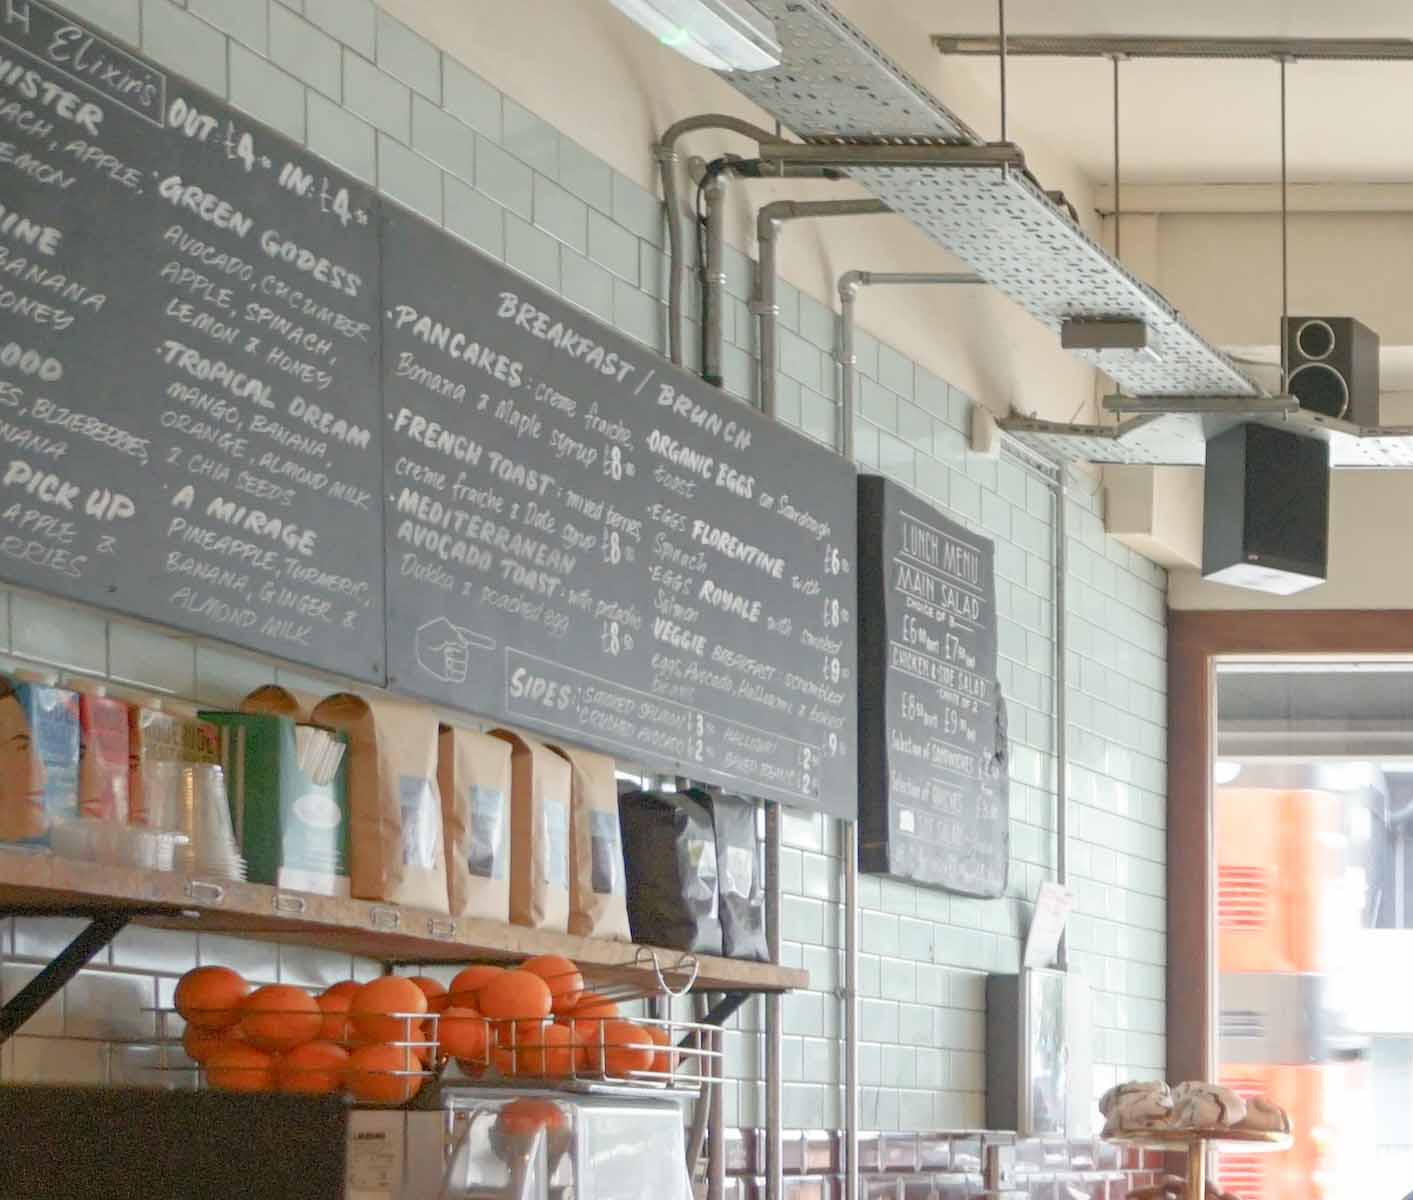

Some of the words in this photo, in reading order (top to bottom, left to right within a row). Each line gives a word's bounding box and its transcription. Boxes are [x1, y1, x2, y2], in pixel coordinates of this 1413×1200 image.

[159, 174, 253, 238] GREEN
[260, 228, 362, 297] GODESS
[165, 298, 241, 344] LEMON
[162, 340, 276, 410] TROPICAL
[287, 395, 371, 449] DREAM
[496, 291, 636, 383] BREAKFAST
[658, 383, 752, 451] BRUNCH
[393, 407, 484, 466] FRENCH
[649, 429, 716, 481] ORGANIC
[715, 462, 755, 500] EGGS
[3, 459, 82, 512] PICK
[85, 487, 137, 521] UP
[187, 454, 232, 483] CHIA
[1, 503, 78, 545] APPLE
[171, 484, 195, 510] A
[206, 496, 319, 557] MIRAGE
[397, 487, 577, 576] MEDITERRANEAN
[691, 519, 786, 580] FLORENTINE
[396, 519, 493, 572] AVOCADO
[499, 558, 561, 600] TOAST
[902, 521, 939, 567] LUNCH
[943, 541, 979, 585] MENU
[698, 578, 764, 624] ROYALE
[896, 566, 936, 602] MAIN
[940, 583, 980, 620] SALAD
[653, 615, 708, 657] VEGGIE
